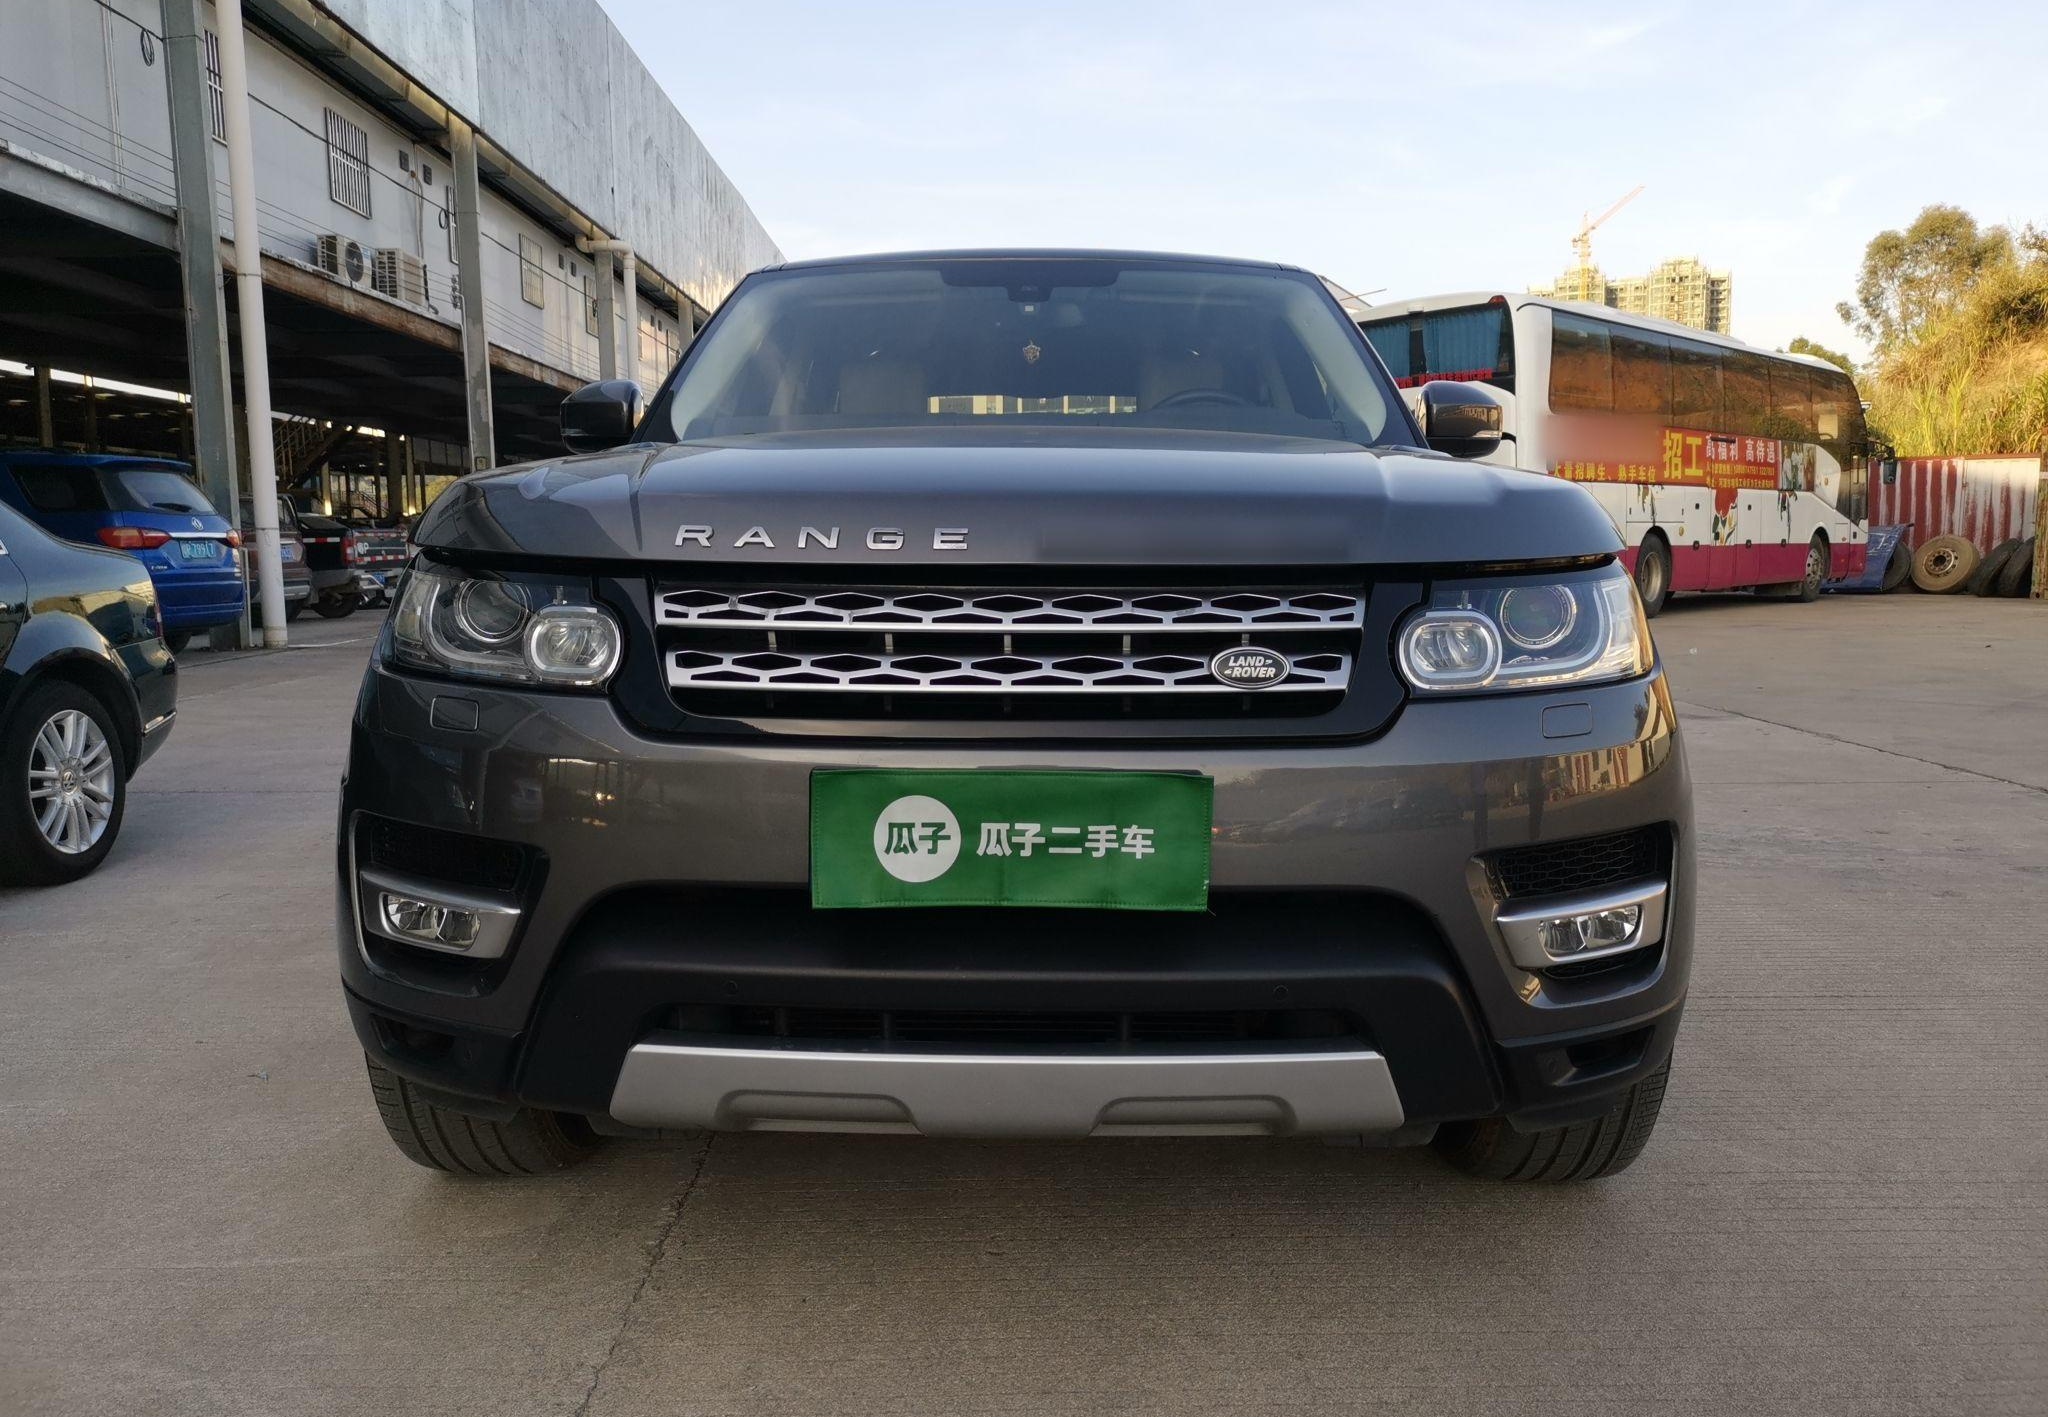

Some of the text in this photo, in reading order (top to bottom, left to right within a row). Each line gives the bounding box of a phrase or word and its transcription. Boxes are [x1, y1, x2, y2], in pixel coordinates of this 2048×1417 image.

[1662, 429, 1704, 480] 招工
[674, 524, 969, 550] RANGE
[1228, 656, 1265, 667] LAND
[1231, 667, 1276, 678] ROVER
[884, 821, 1155, 860] 瓜子 瓜子二手车
